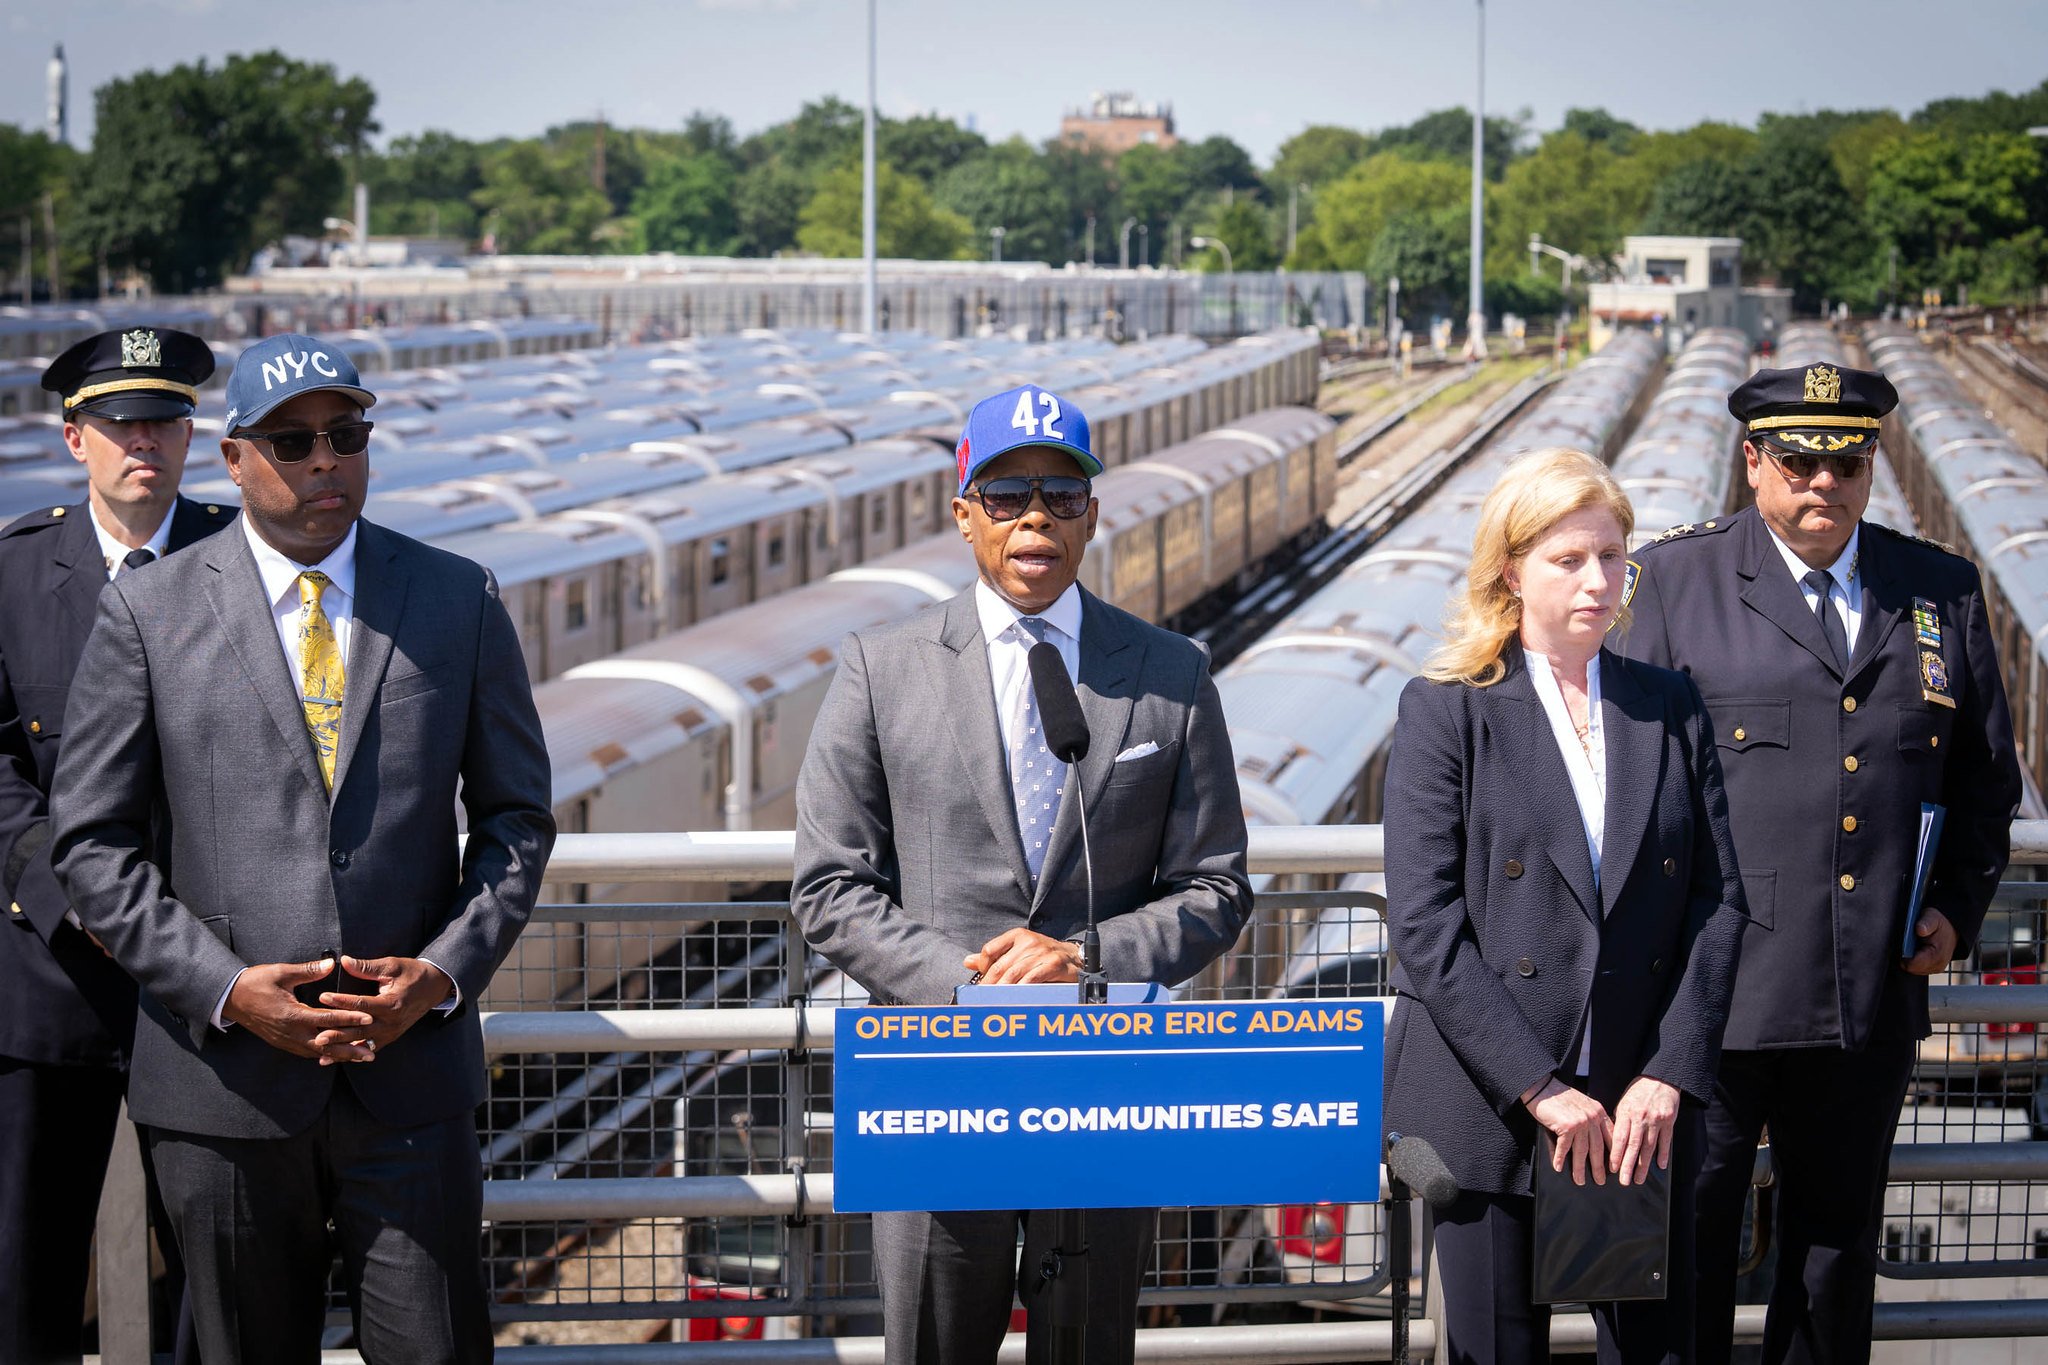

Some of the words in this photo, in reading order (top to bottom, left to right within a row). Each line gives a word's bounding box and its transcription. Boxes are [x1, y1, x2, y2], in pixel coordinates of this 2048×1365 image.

[261, 351, 338, 391] NYC
[1011, 391, 1064, 440] 42
[855, 1015, 971, 1039] OFFICE
[982, 1013, 1027, 1037] OF
[1038, 1012, 1153, 1036] MAYOR
[1165, 1011, 1237, 1034] ERIC
[1247, 1009, 1363, 1033] ADAMS
[857, 1108, 1009, 1135] KEEPING
[1018, 1103, 1264, 1132] COMMUNITIES
[1271, 1102, 1358, 1128] SAFE
